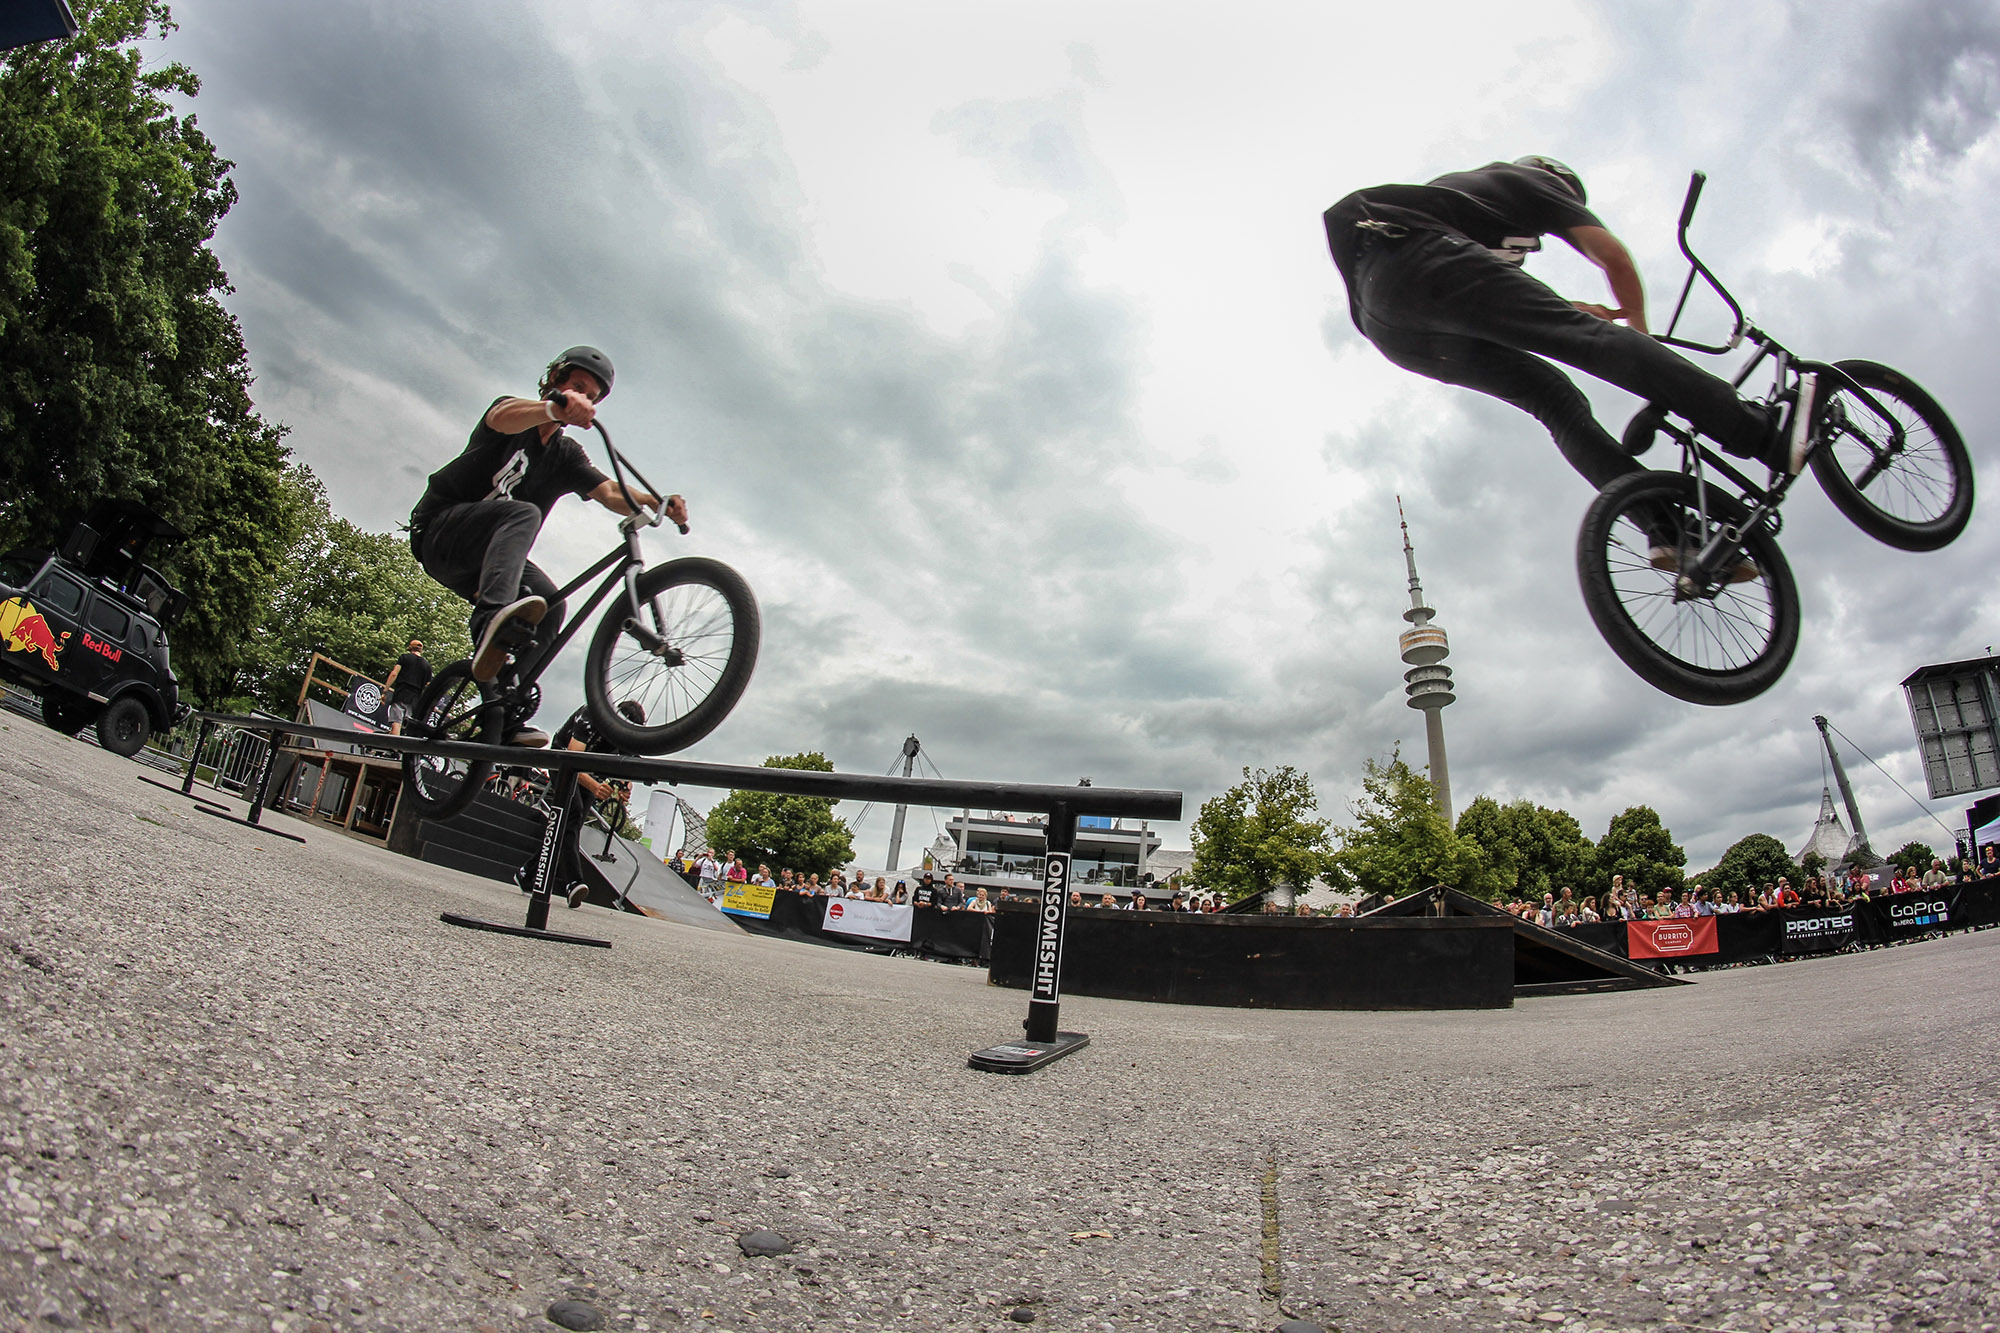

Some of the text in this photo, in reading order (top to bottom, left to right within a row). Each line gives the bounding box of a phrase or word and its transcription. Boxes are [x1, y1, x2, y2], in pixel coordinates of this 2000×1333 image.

[82, 633, 122, 663] Red Bull
[534, 810, 558, 888] ONSOMESHIT
[1037, 860, 1064, 995] ONSOMESHIT
[1658, 932, 1688, 940] BURRITO
[1786, 915, 1853, 933] PRO-TEC
